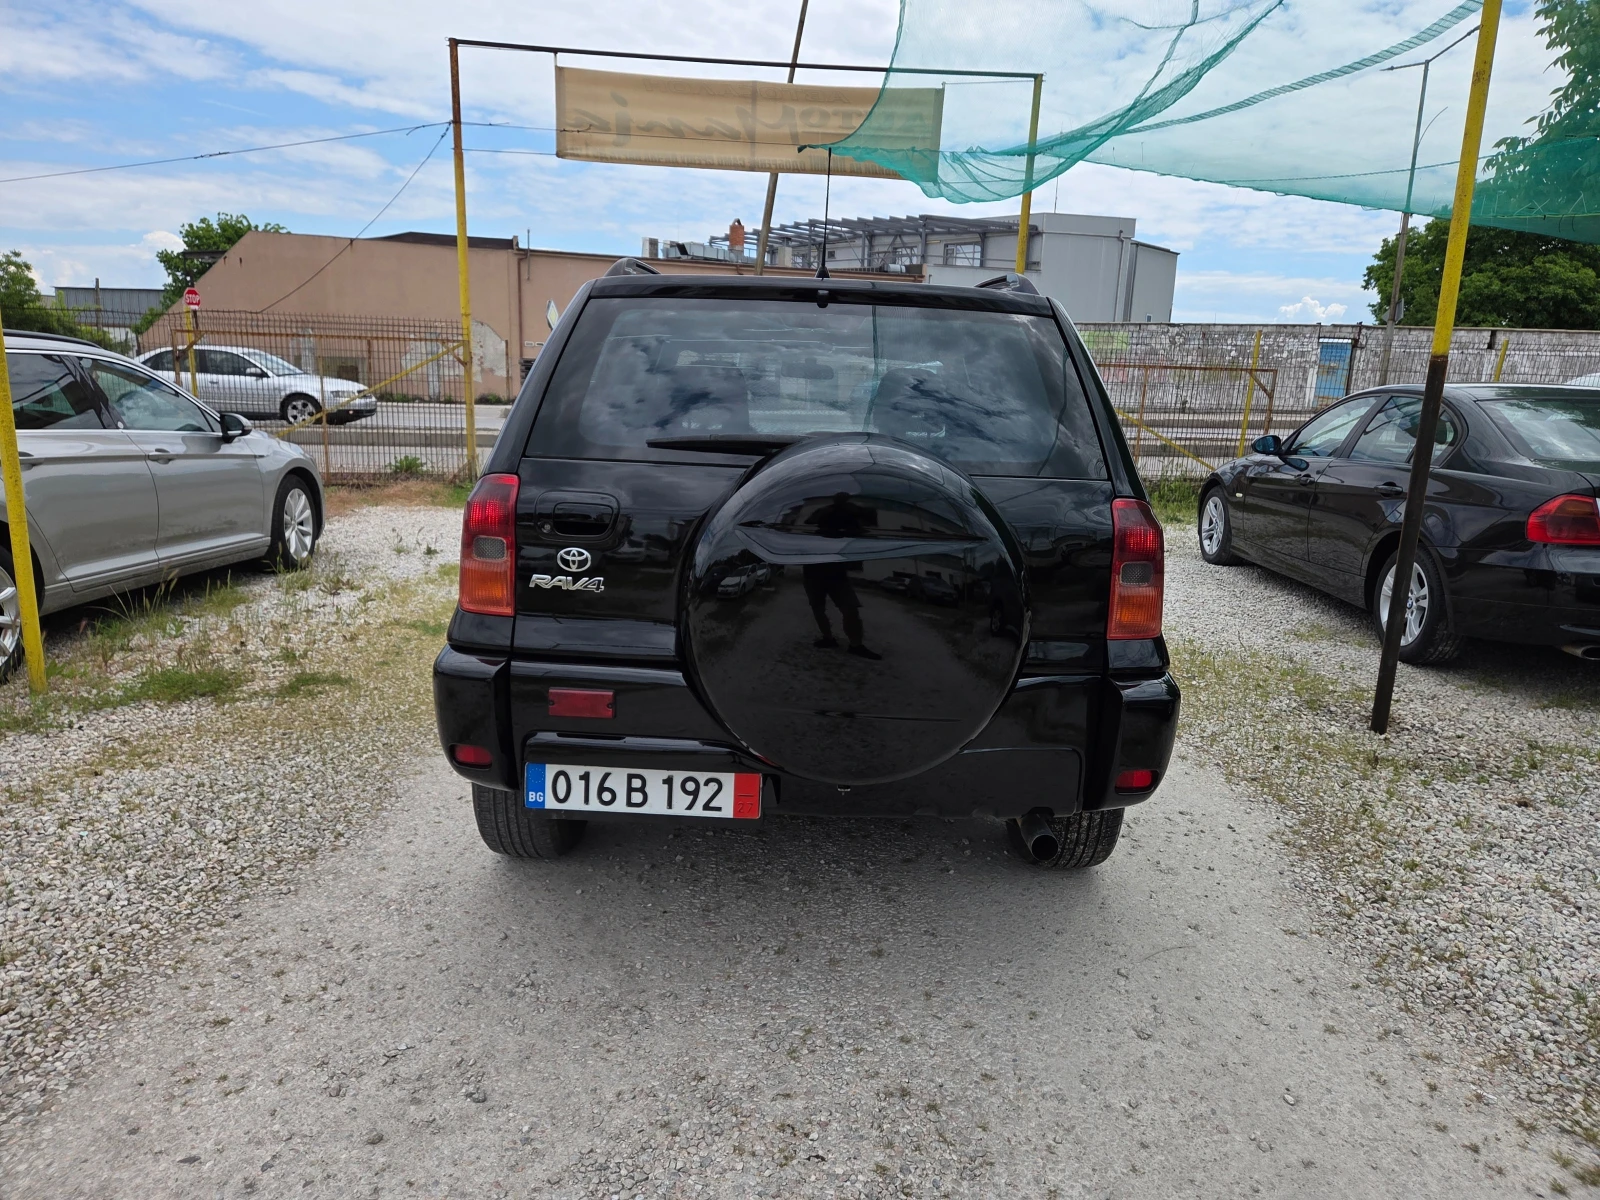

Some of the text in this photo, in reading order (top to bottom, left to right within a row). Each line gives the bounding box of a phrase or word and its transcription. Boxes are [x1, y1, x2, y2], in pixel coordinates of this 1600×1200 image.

[185, 294, 200, 304] STOP
[529, 574, 604, 592] RAV4
[528, 791, 544, 803] BG
[737, 801, 753, 813] 27
